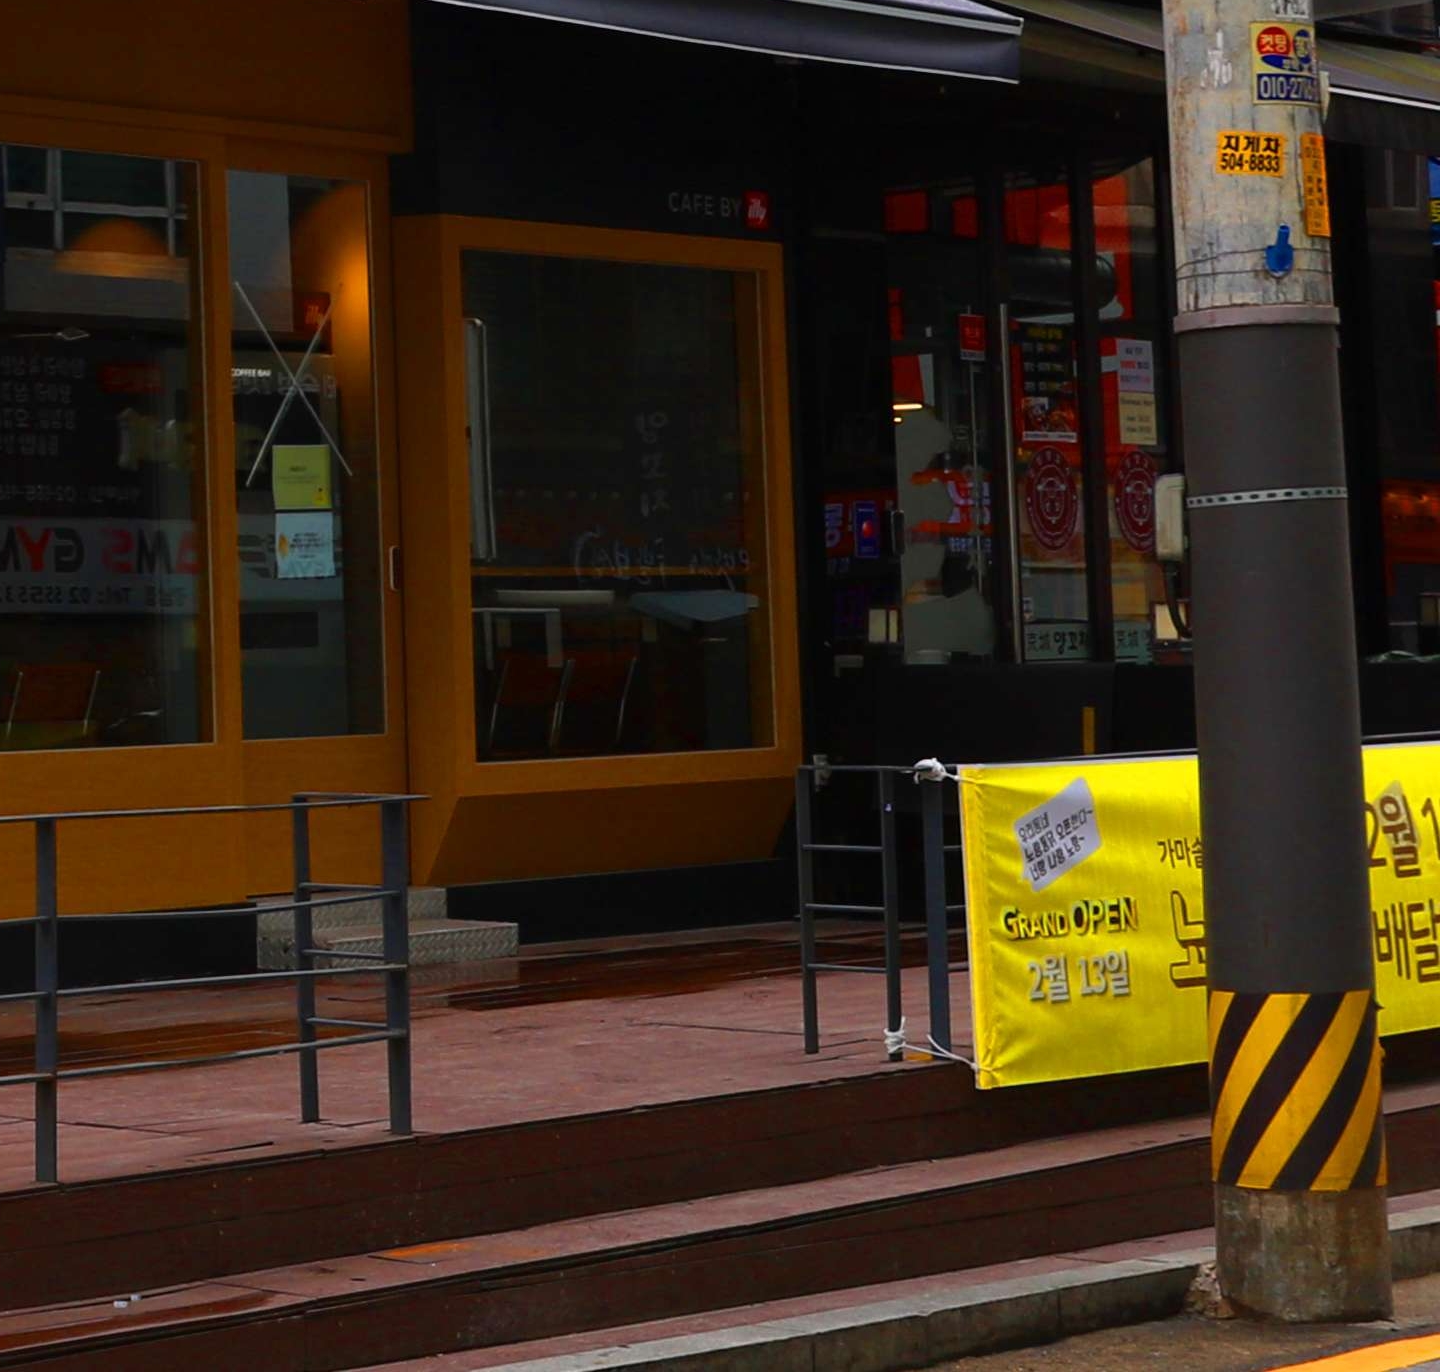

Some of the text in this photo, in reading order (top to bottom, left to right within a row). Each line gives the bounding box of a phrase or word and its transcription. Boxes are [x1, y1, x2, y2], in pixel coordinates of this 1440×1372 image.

[1223, 135, 1281, 153] 지게차
[669, 191, 714, 216] CAFE
[721, 196, 741, 218] BY
[1072, 896, 1139, 937] OPEN
[1028, 950, 1131, 1004] 2월 13일
